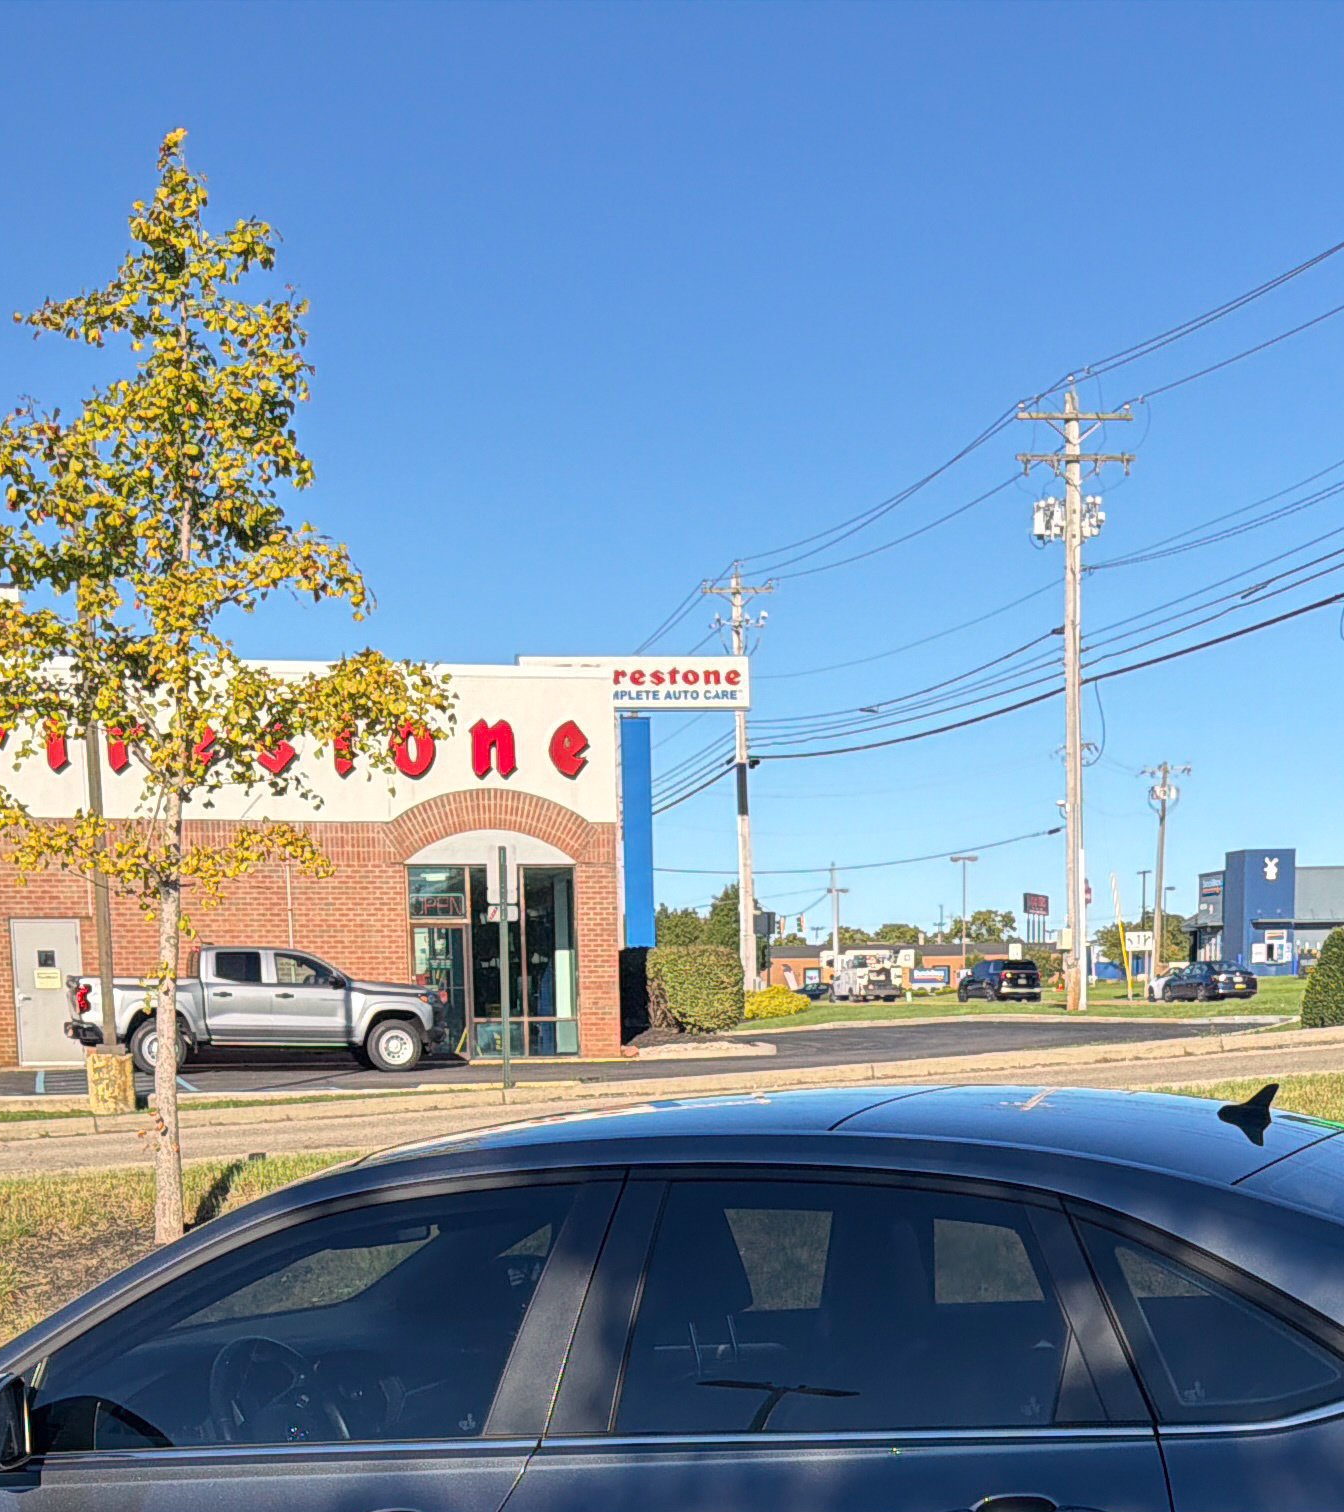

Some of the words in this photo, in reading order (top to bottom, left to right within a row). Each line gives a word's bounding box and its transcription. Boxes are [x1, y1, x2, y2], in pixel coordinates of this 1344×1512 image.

[613, 667, 741, 686] restone
[664, 690, 699, 701] AUTO
[704, 690, 737, 700] CARE
[410, 896, 463, 915] OPEN
